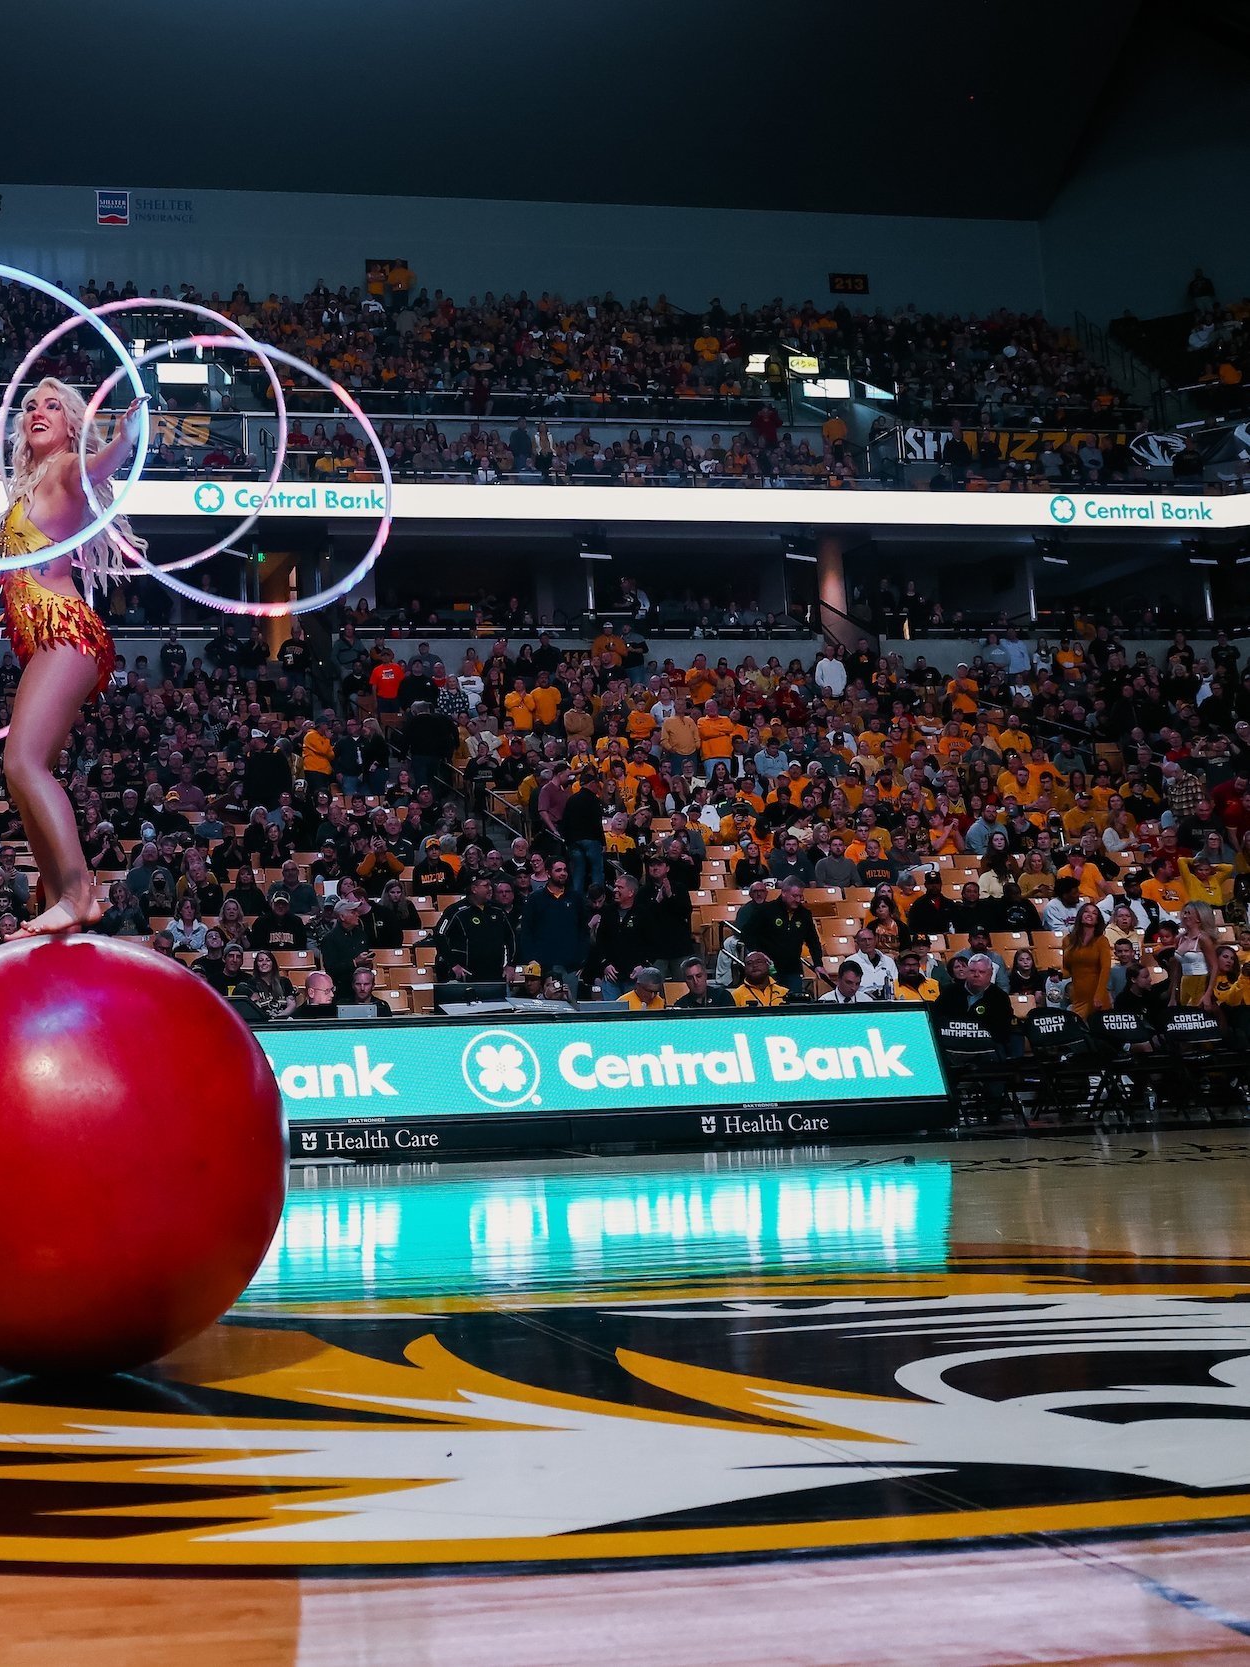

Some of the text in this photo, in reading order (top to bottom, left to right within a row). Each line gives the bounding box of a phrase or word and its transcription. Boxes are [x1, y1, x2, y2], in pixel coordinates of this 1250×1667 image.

[135, 198, 192, 211] SHELTER
[135, 212, 194, 224] INSURANCE
[833, 277, 864, 290] 213
[234, 488, 385, 509] Central Bank
[1085, 501, 1213, 520] Central Bank
[866, 869, 892, 878] MIZZOU
[1033, 1015, 1065, 1027] COACH
[1102, 1014, 1136, 1023] COACH
[1173, 1013, 1204, 1023] COACH
[949, 1021, 979, 1030] COACH
[1038, 1023, 1064, 1034] NUTT
[1103, 1021, 1138, 1030] YOUNG
[1166, 1020, 1219, 1032] SHARBAUGH
[558, 1028, 914, 1090] Central Bank
[268, 1045, 399, 1099] ank
[723, 1114, 784, 1134] Health
[787, 1113, 830, 1132] Care
[325, 1131, 390, 1151] Health
[394, 1129, 440, 1150] Care
